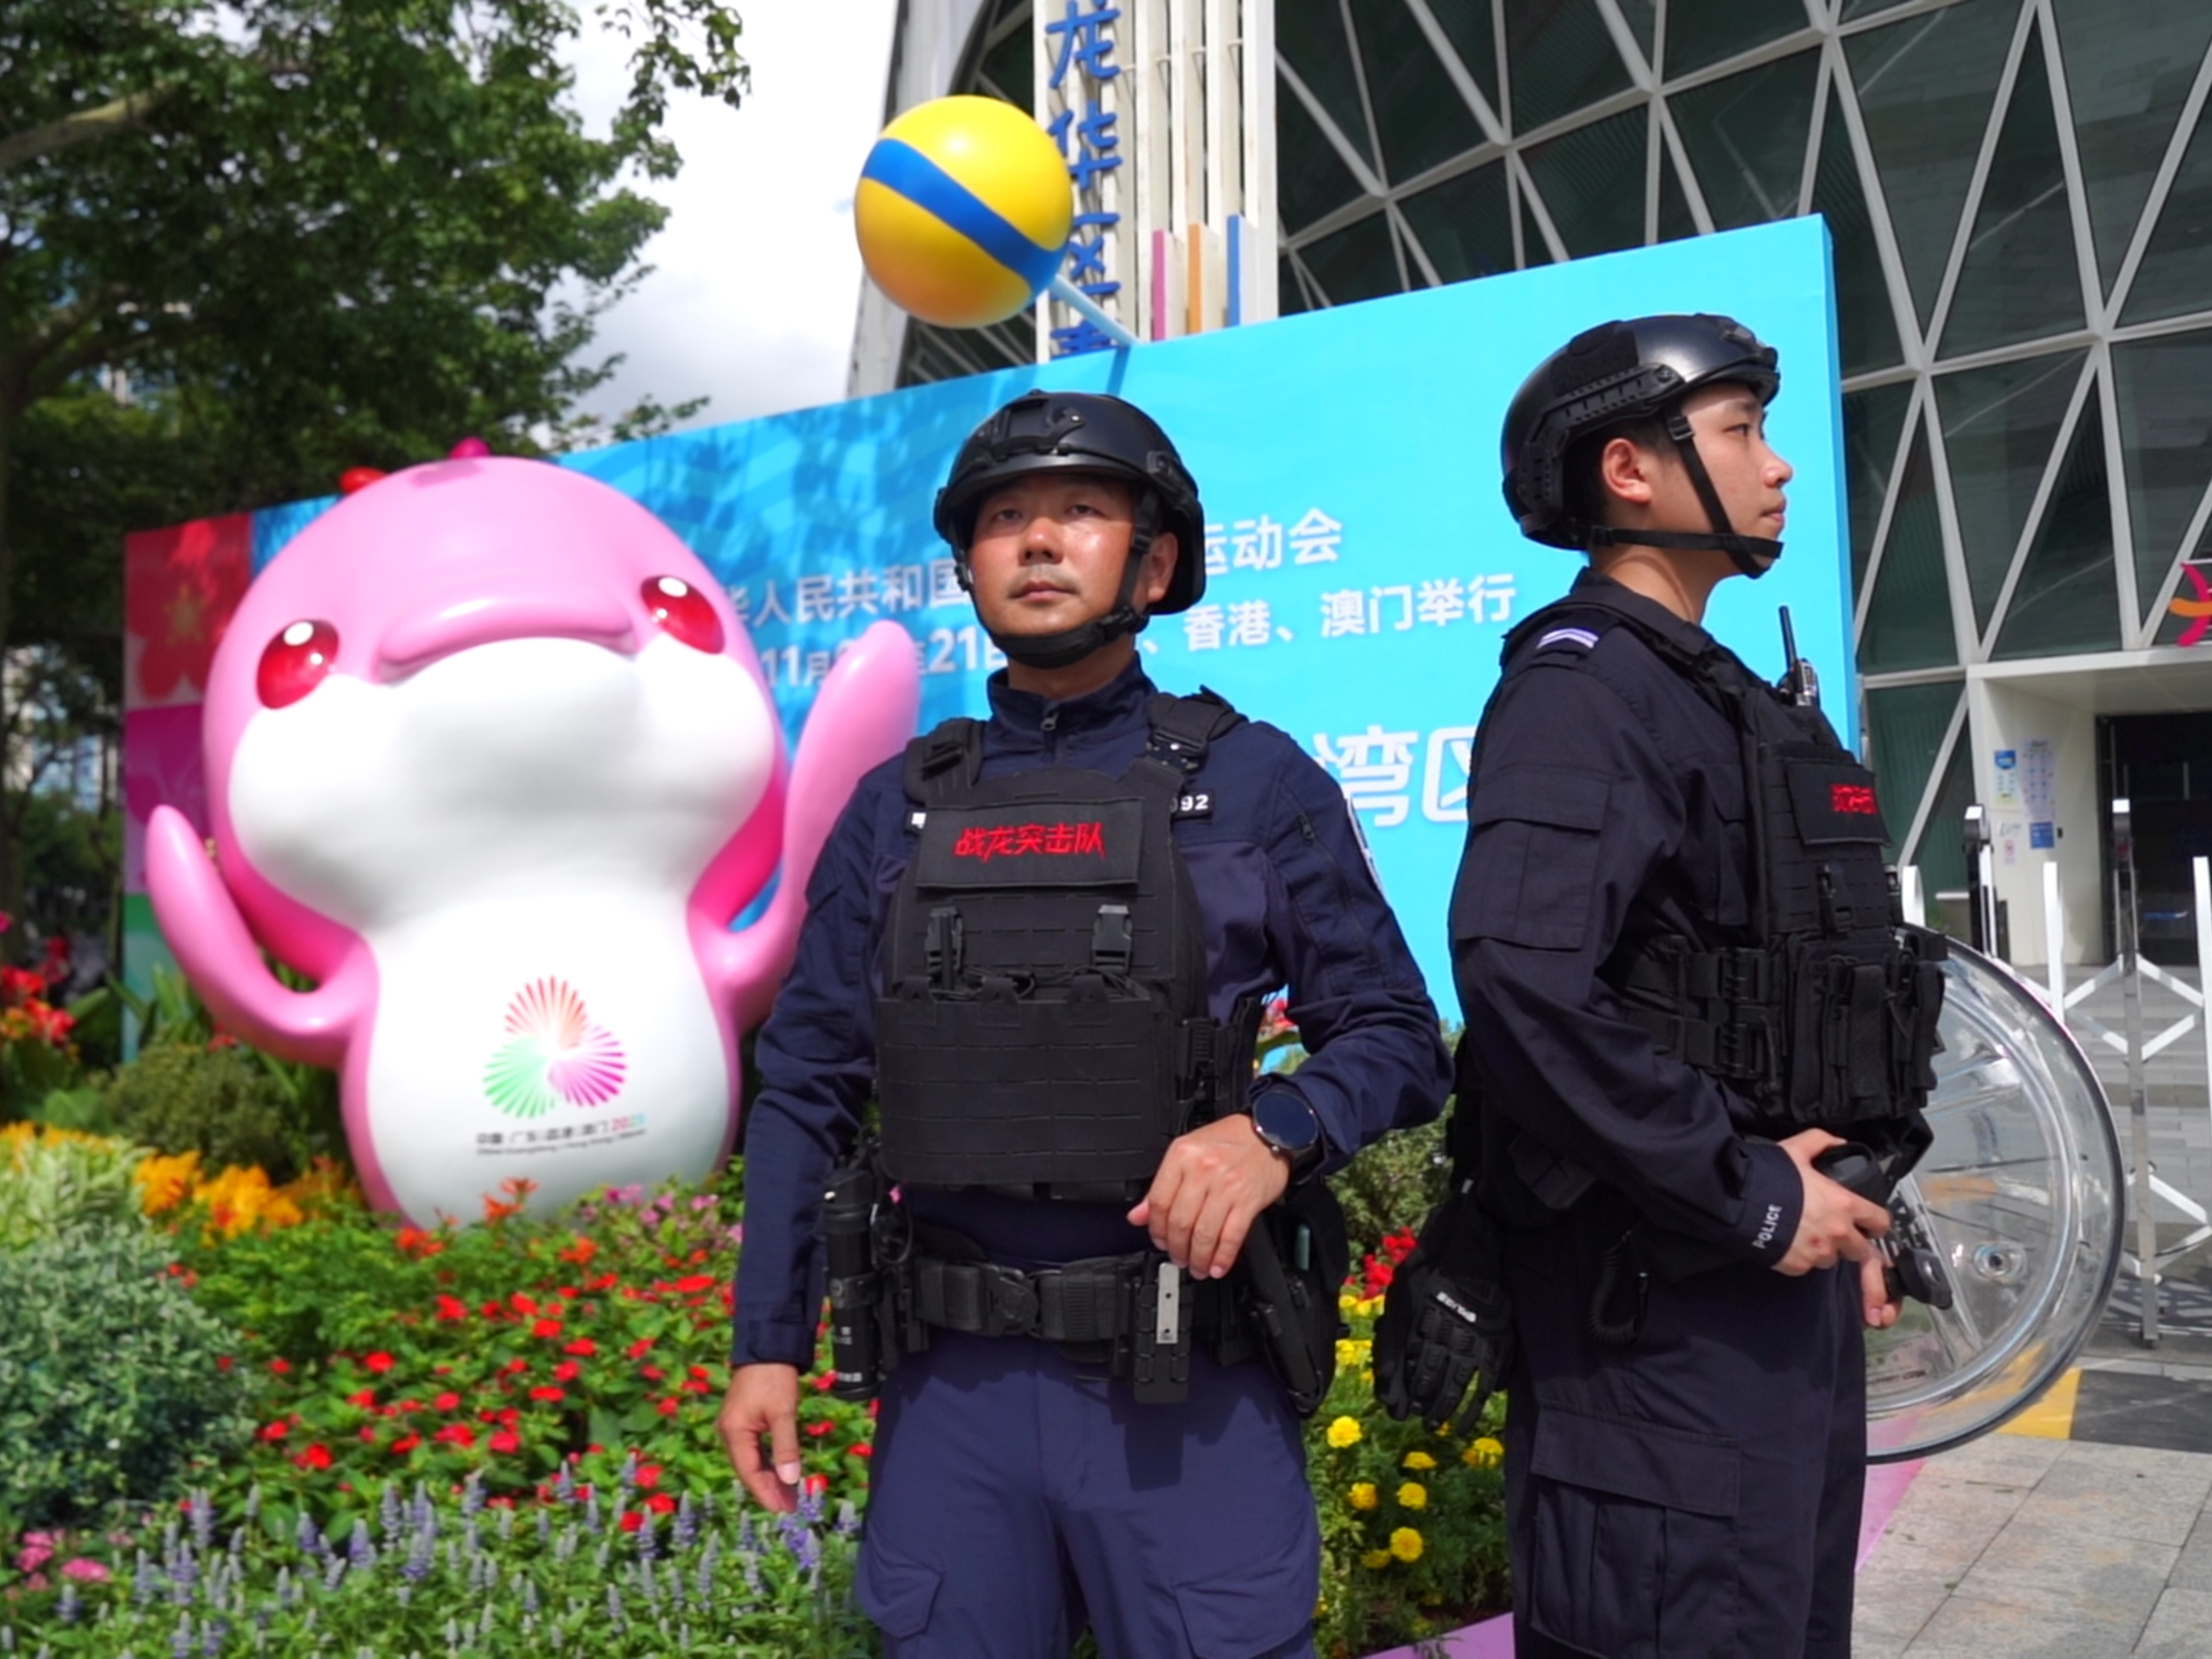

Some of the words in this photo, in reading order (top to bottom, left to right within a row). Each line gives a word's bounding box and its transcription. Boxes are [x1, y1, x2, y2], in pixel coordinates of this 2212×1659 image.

[762, 641, 854, 687] 11月
[955, 823, 1105, 863] 战龙突击队
[1752, 1204, 1783, 1249] POLICE
